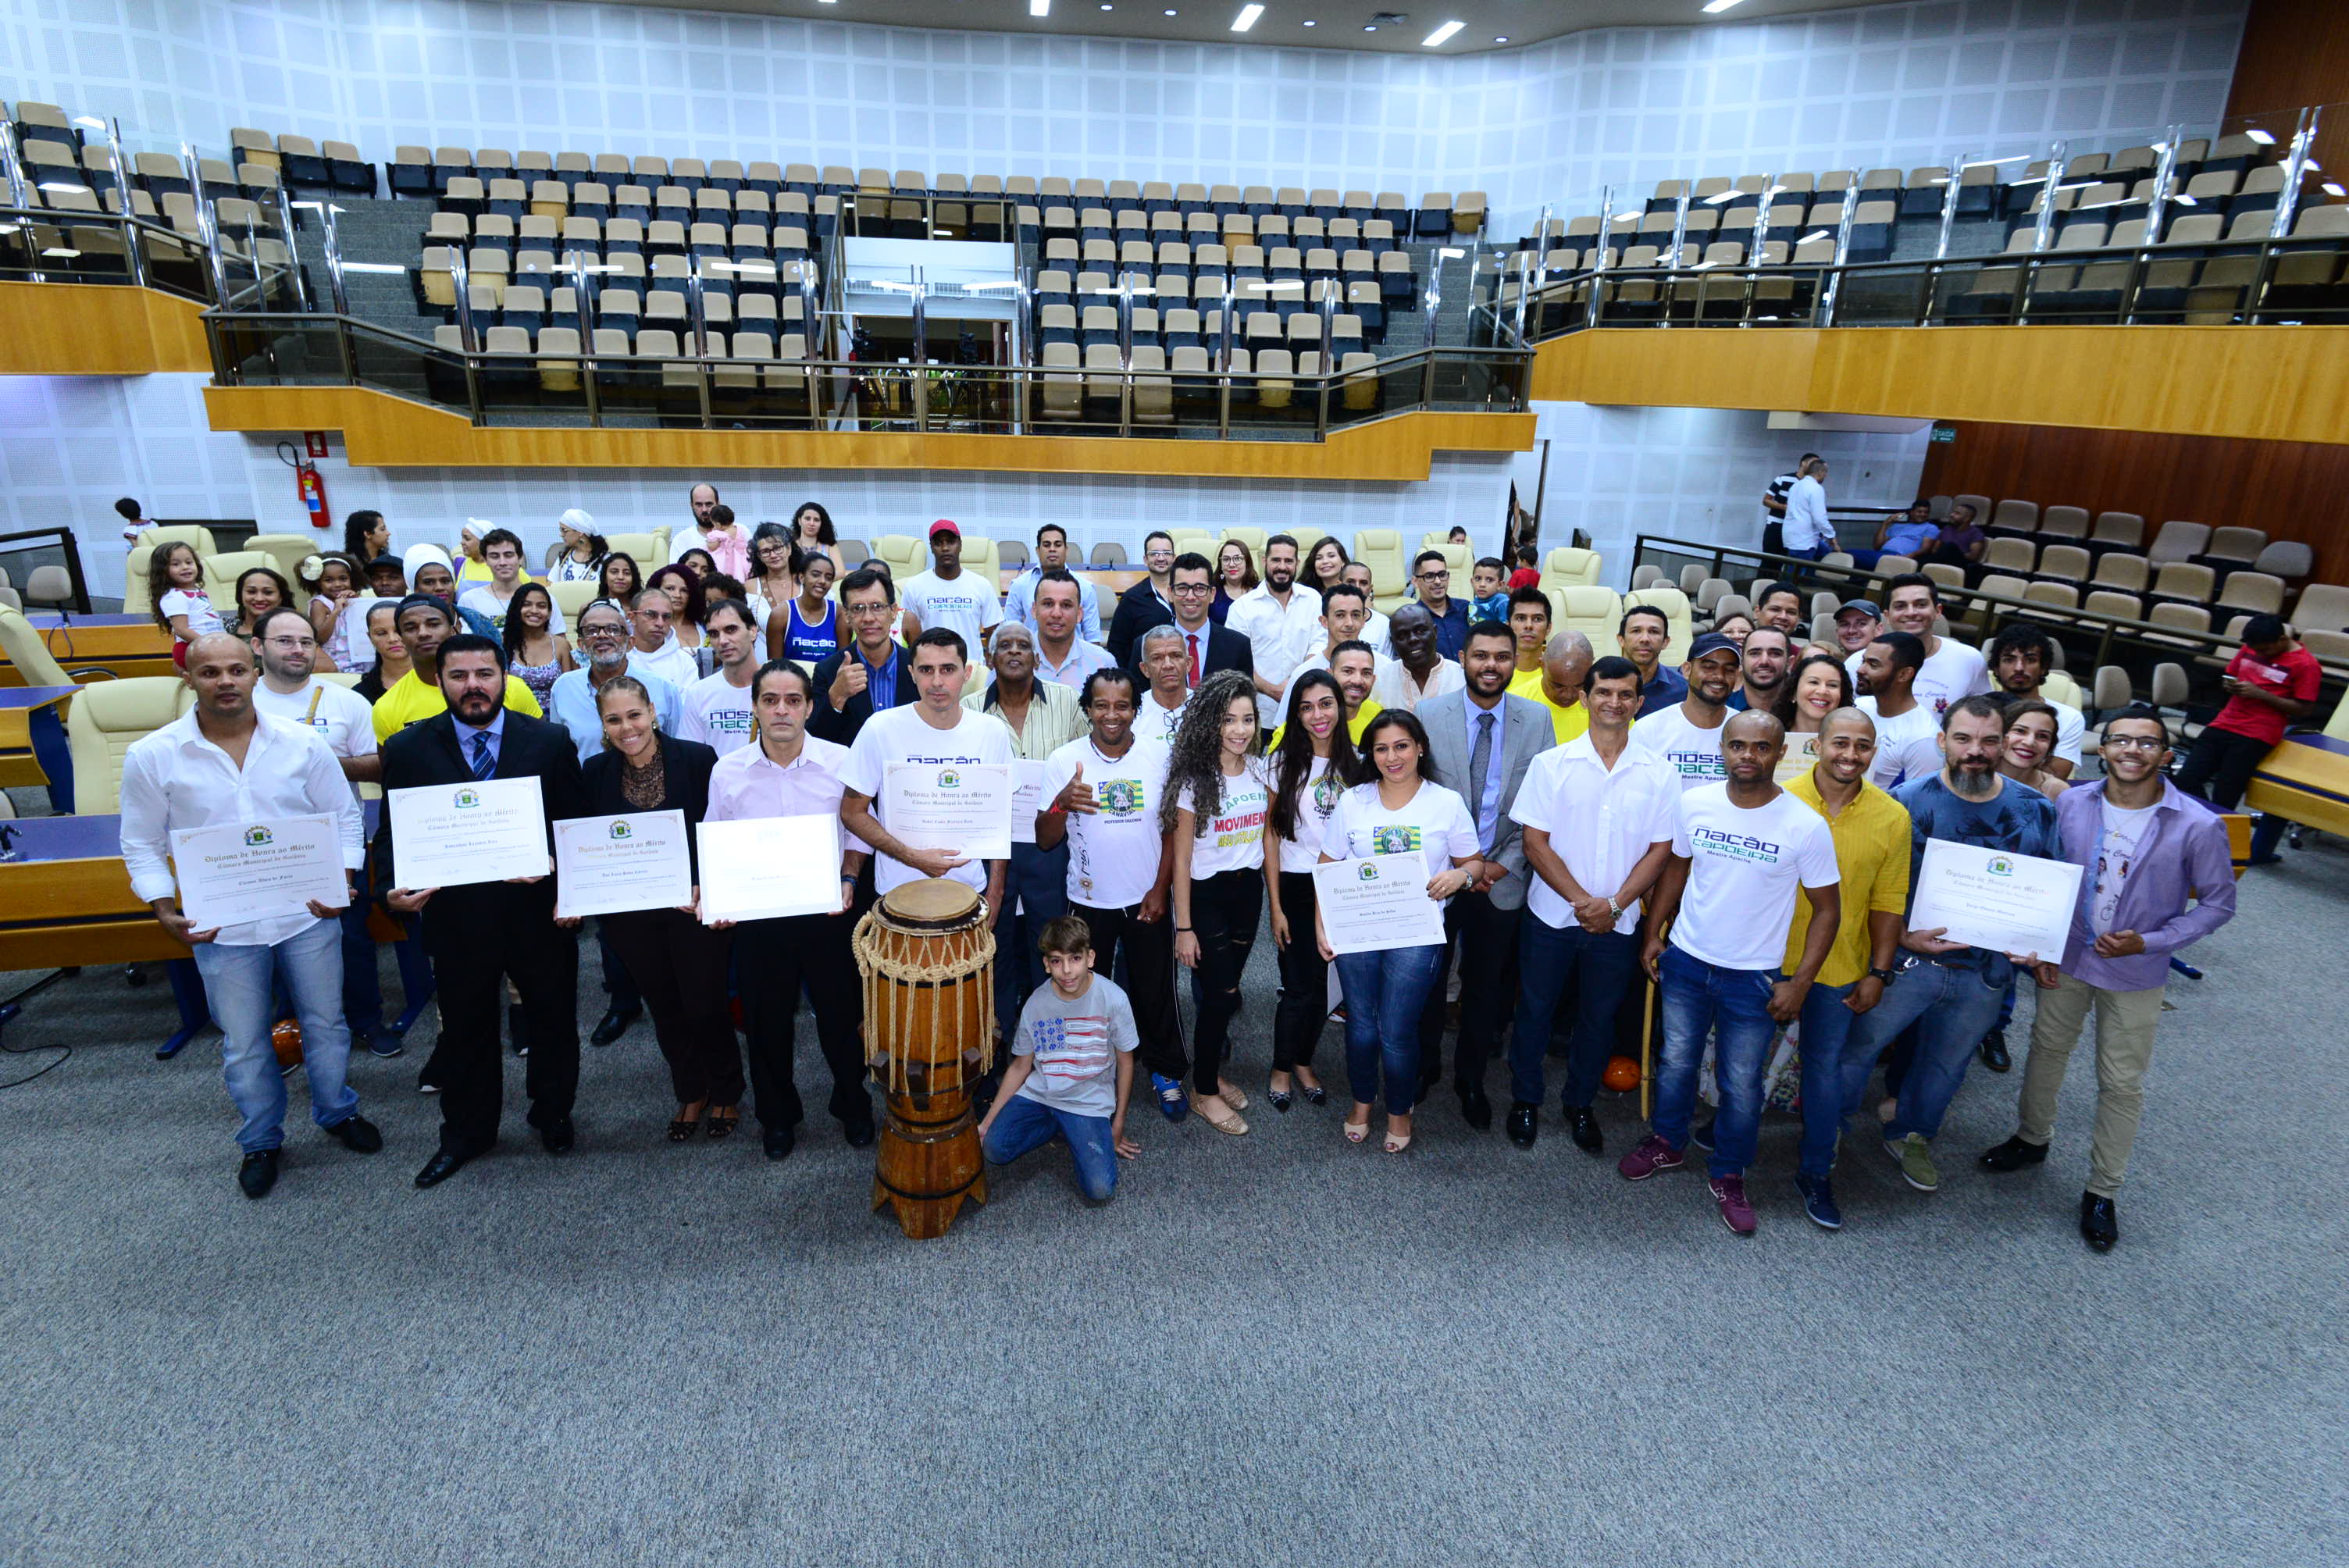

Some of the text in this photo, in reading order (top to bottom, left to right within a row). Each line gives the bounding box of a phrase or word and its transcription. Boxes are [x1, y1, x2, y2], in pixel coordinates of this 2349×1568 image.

[903, 789, 929, 800] Diploma
[1220, 793, 1268, 817] APOEIR
[1214, 811, 1267, 832] MOVIMEN
[204, 852, 238, 864] Diploma
[1707, 850, 1752, 864] Mestre Apache
